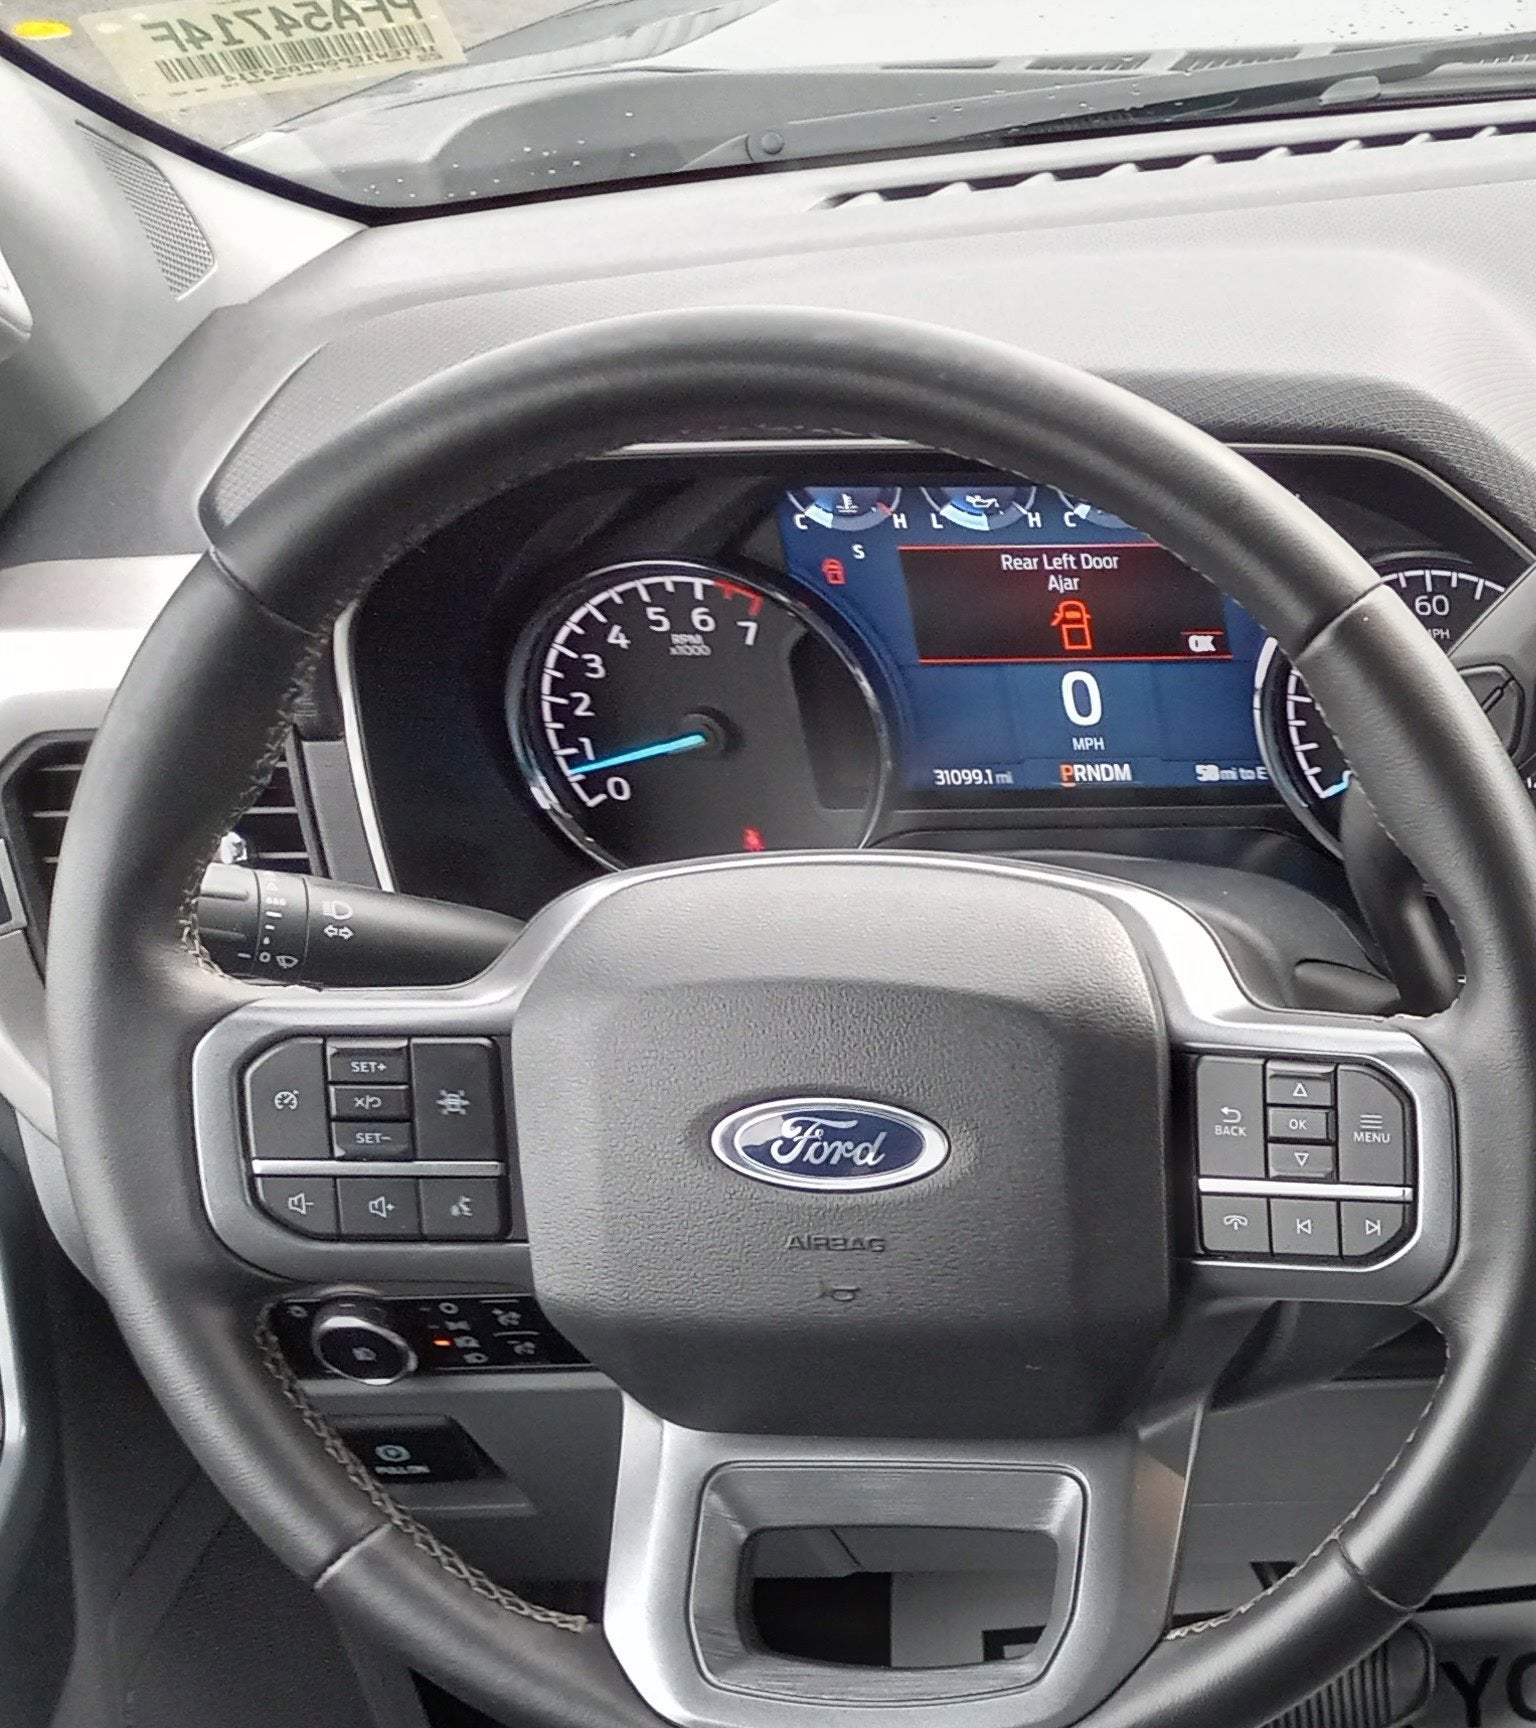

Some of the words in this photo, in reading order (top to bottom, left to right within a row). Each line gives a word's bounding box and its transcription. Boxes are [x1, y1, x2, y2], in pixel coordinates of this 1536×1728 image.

[795, 513, 808, 530] C
[892, 513, 908, 529] H
[931, 513, 944, 529] L
[1028, 513, 1041, 528] H
[1064, 513, 1077, 528] C
[852, 544, 865, 559] S
[1000, 554, 1040, 571] Rear
[1043, 554, 1078, 570] Left
[1080, 553, 1120, 569] Door
[1048, 574, 1080, 593] Ajar
[1415, 595, 1450, 616] 60
[646, 607, 670, 632] 5
[691, 607, 716, 632] 6
[607, 625, 631, 649] 4
[736, 621, 758, 646] 7
[1188, 635, 1216, 652] OK
[581, 654, 606, 678] 3
[569, 692, 595, 716] 2
[1061, 671, 1103, 726] 0
[578, 737, 595, 760] 1
[1072, 737, 1105, 750] MPH
[933, 769, 993, 785] 31099.1
[1060, 763, 1132, 782] PRNDM
[607, 776, 631, 801] 0
[351, 1061, 387, 1073] SET+
[1214, 1125, 1247, 1137] BACK
[1289, 1119, 1308, 1130] OK
[770, 1116, 887, 1167] Ford
[1353, 1131, 1391, 1144] MENU
[787, 1234, 887, 1253] AIRBAG
